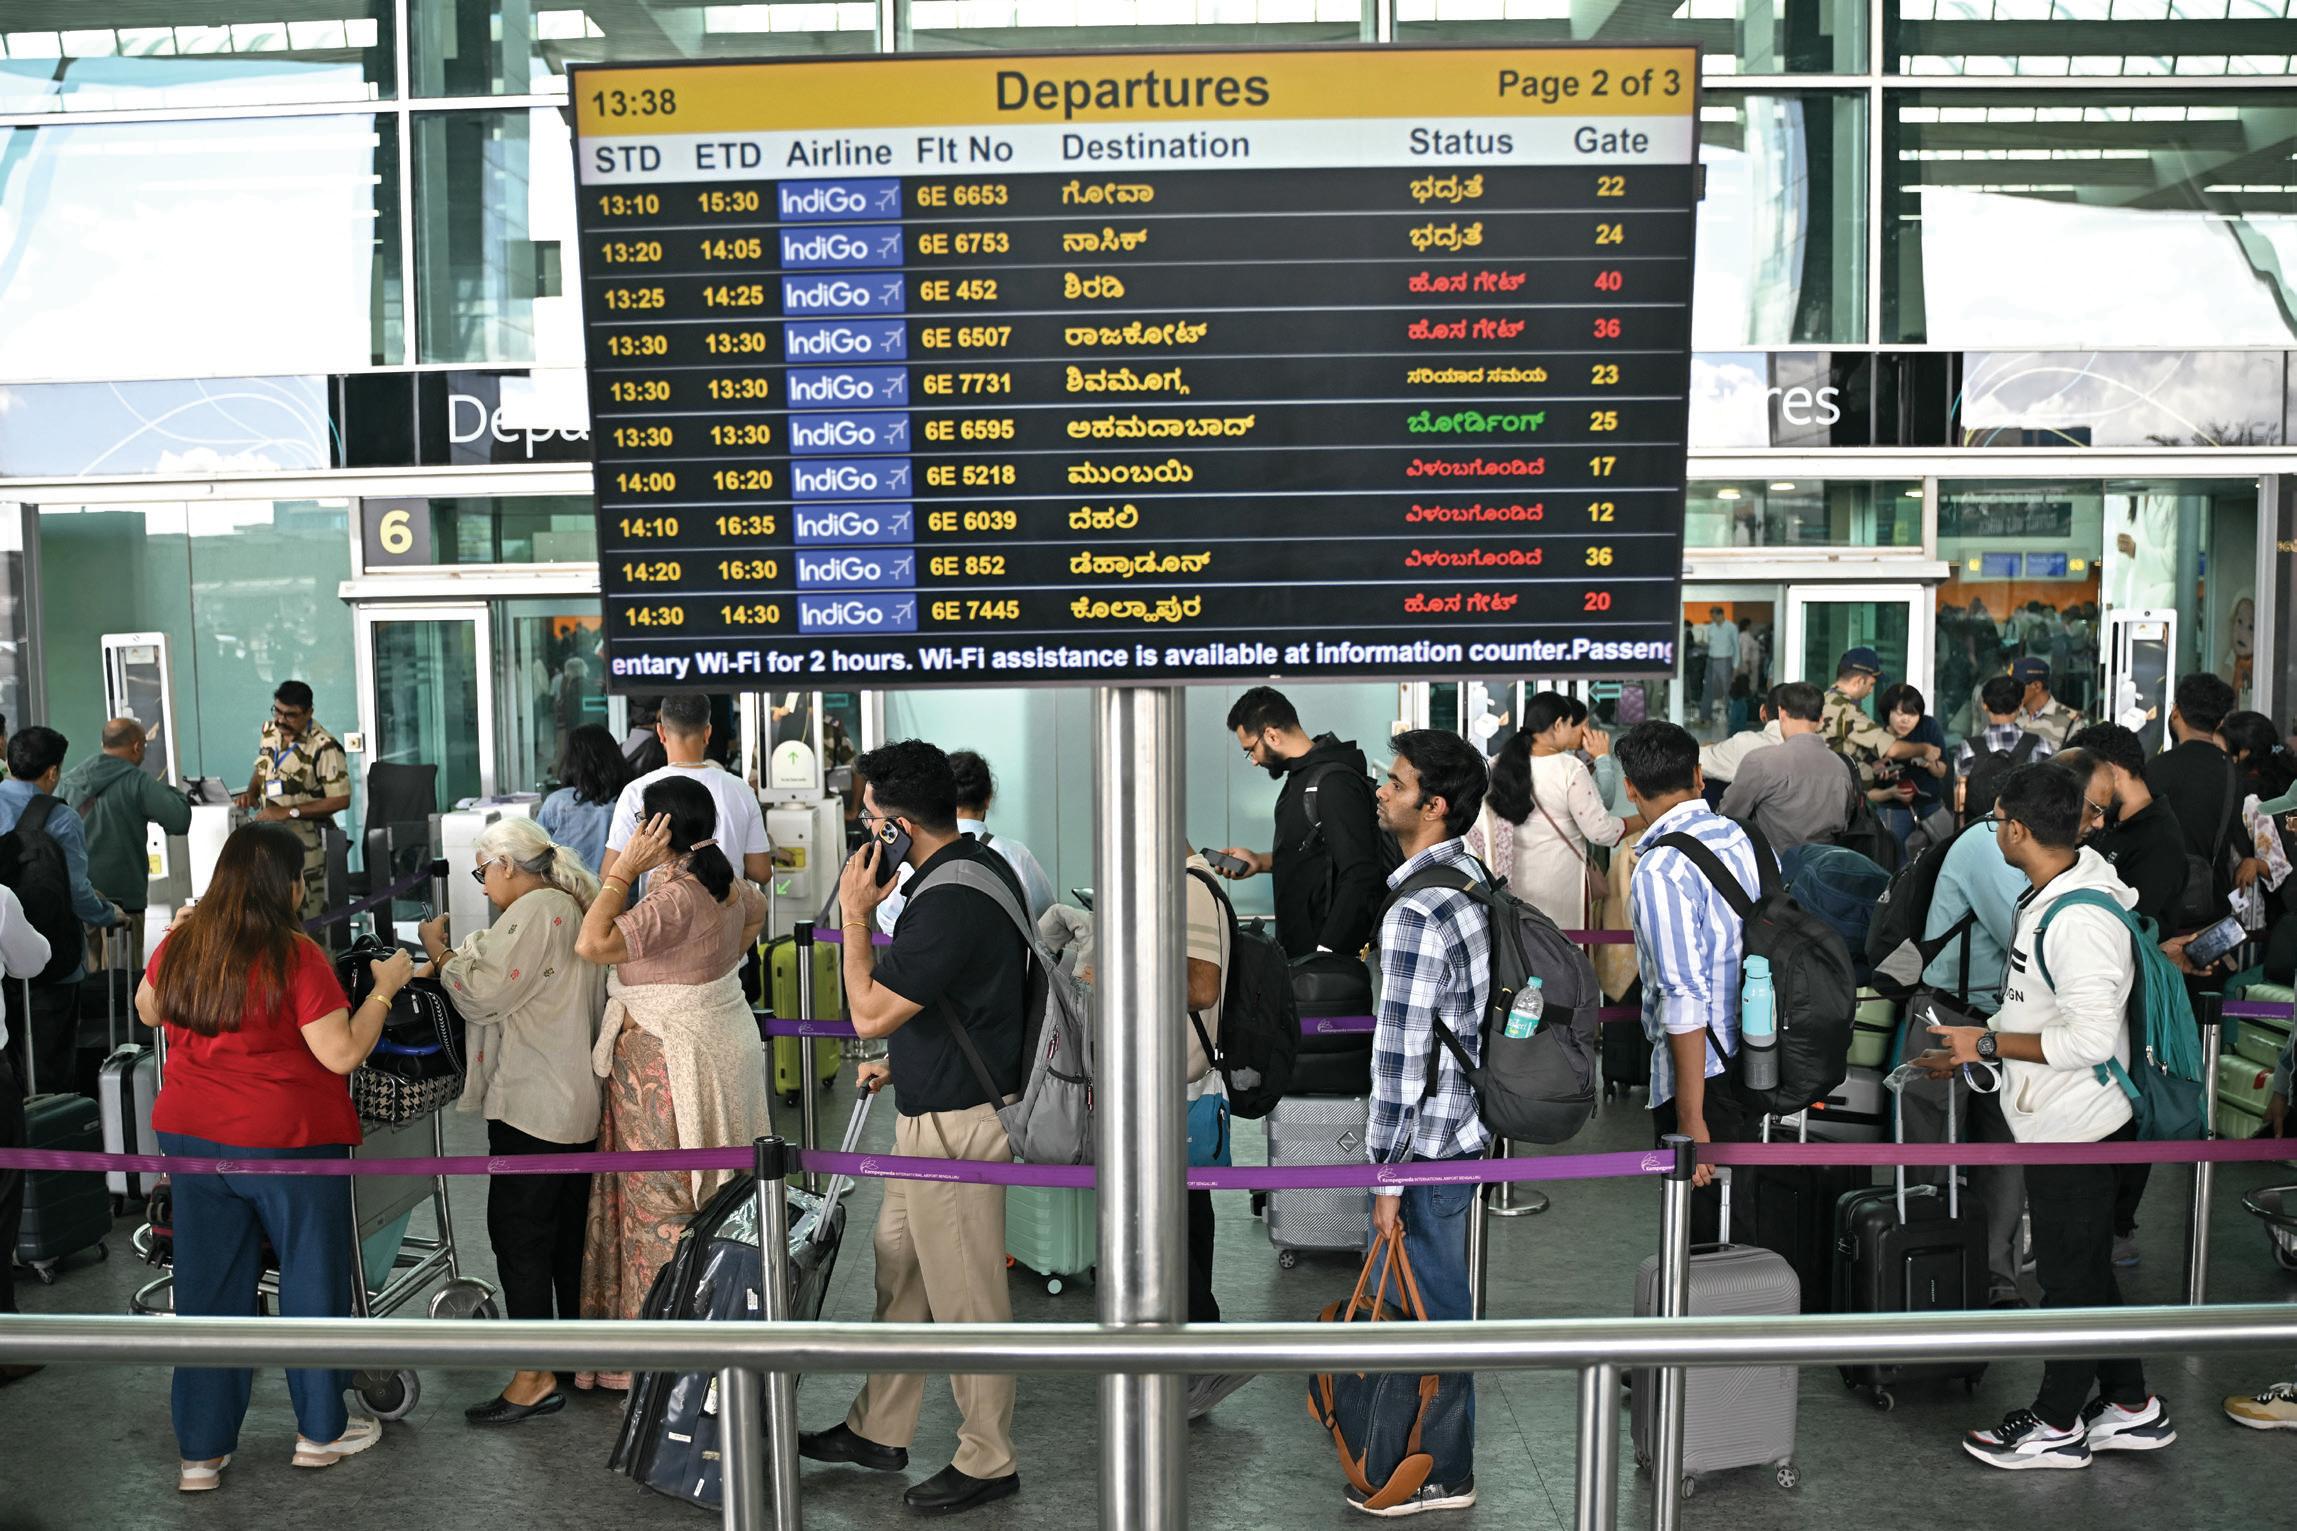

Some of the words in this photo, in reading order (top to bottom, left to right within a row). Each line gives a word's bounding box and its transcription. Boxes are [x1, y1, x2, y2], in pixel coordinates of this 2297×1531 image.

[996, 71, 1270, 119] Departures
[1499, 70, 1579, 103] Page
[1592, 70, 1609, 95] 2
[1621, 69, 1654, 96] of
[1664, 69, 1681, 95] 3
[593, 89, 677, 117] 13:38
[918, 138, 958, 163] Flt
[969, 136, 1013, 162] No
[1062, 132, 1249, 159] Destination
[1410, 128, 1513, 155] Status
[1574, 127, 1648, 153] Gate
[596, 146, 661, 173] STD
[696, 142, 762, 170] ETD
[787, 140, 892, 167] Airline
[917, 186, 947, 207] 6E
[953, 185, 1009, 206] 6653
[1062, 181, 1155, 204] ಗೋವಾ
[1410, 175, 1484, 203] ಭದ್ರತೆ
[1598, 176, 1625, 197] 22
[601, 195, 660, 215] 13:10
[699, 192, 760, 213] 15:30
[783, 188, 865, 212] IndiGo
[918, 234, 950, 255] 6E
[954, 233, 1009, 254] 6753
[1063, 228, 1148, 252] ನಾಸಿಕ್
[1410, 223, 1483, 252] ಭದ್ರತೆ
[1596, 224, 1624, 244] 24
[603, 242, 663, 263] 13:20
[702, 239, 762, 259] 14:05
[785, 235, 867, 260] IndiGo
[920, 280, 950, 301] 6E
[956, 280, 998, 301] 452
[1064, 272, 1125, 299] ಶಿರಡಿ
[1409, 272, 1468, 293] ಹೊಸ
[1473, 272, 1526, 292] ಗೇಟ್
[1594, 272, 1623, 291] 40
[606, 288, 666, 309] 13:25
[703, 285, 765, 306] 14:25
[787, 282, 869, 307] IndiGo
[922, 328, 952, 349] 6E
[957, 327, 1012, 347] 6507
[1065, 321, 1208, 346] ರಾಜಕೋಟ್
[1407, 320, 1468, 340] ಹೊಸ
[1472, 319, 1526, 339] ಗೇಟ್
[1593, 319, 1621, 339] 36
[608, 336, 669, 356] 13:30
[705, 332, 767, 353] 13:30
[789, 329, 871, 353] IndiGo
[923, 374, 954, 395] 6E
[959, 373, 1012, 393] 7731
[1066, 366, 1191, 395] ಶಿವಮೊಗ್ಗ
[1407, 368, 1485, 385] ಸರಿಯಾದ
[1486, 367, 1548, 383] ಸಮಯ
[1592, 365, 1620, 385] 23
[612, 381, 671, 401] 13:30
[708, 379, 769, 400] 13:30
[791, 375, 873, 400] IndiGo
[924, 420, 955, 441] 6E
[960, 420, 1015, 440] 6595
[1067, 416, 1256, 439] ಅಹಮದಾಬಾದ್
[1407, 411, 1545, 433] ಬೋರ್ಡಿಂಗ್
[1590, 411, 1618, 431] 25
[614, 427, 673, 448] 13:30
[711, 425, 772, 446] 13:30
[793, 421, 875, 446] IndiGo
[927, 466, 957, 486] 6E
[962, 465, 1017, 485] 5218
[1068, 460, 1194, 484] ಮುಂಬಯಿ
[1406, 458, 1546, 477] ವಿಳಂಬಗೊಂಡಿದೆ
[1590, 456, 1617, 476] 17
[617, 472, 677, 493] 14:00
[714, 470, 773, 491] 16:20
[795, 467, 877, 491] IndiGo
[928, 512, 958, 532] 6E
[963, 512, 1018, 531] 6039
[1069, 505, 1140, 529] ದೆಹಲಿ
[1405, 504, 1544, 523] ವಿಳಂಬಗೊಂಡಿದೆ
[1589, 502, 1615, 522] 12
[379, 509, 413, 554] 6
[620, 518, 679, 537] 14:10
[716, 516, 776, 536] 16:35
[798, 512, 879, 536] IndiGo
[930, 556, 960, 576] 6E
[965, 556, 1006, 576] 852
[1070, 552, 1211, 578] ಡೆಹ್ರಾಡೂನ್
[1404, 548, 1543, 567] ವಿಳಂಬಗೊಂಡಿದೆ
[1586, 547, 1614, 567] 36
[623, 562, 682, 582] 14:20
[719, 560, 778, 581] 16:30
[800, 557, 880, 581] IndiGo
[931, 601, 961, 621] 6E
[967, 600, 1021, 620] 7445
[1071, 595, 1201, 623] ಕೊಲ್ಹಾಪುರ
[1404, 593, 1462, 613] ಹೊಸ
[1466, 592, 1518, 613] ಗೇಟ್
[1583, 592, 1612, 612] 20
[626, 608, 685, 625] 14:30
[721, 605, 781, 625] 14:30
[802, 602, 882, 625] IndiGo
[612, 654, 690, 679] entary
[695, 651, 760, 674] Wi-Fi
[767, 651, 804, 672] for
[810, 650, 825, 672] 2
[832, 650, 913, 671] hours.
[919, 647, 984, 670] Wi-Fi
[992, 646, 1128, 668] assistance
[1136, 645, 1158, 666] is
[1165, 643, 1278, 666] available
[1284, 643, 1310, 664] at
[1316, 640, 1462, 663] information
[2005, 987, 2024, 1002] GN
